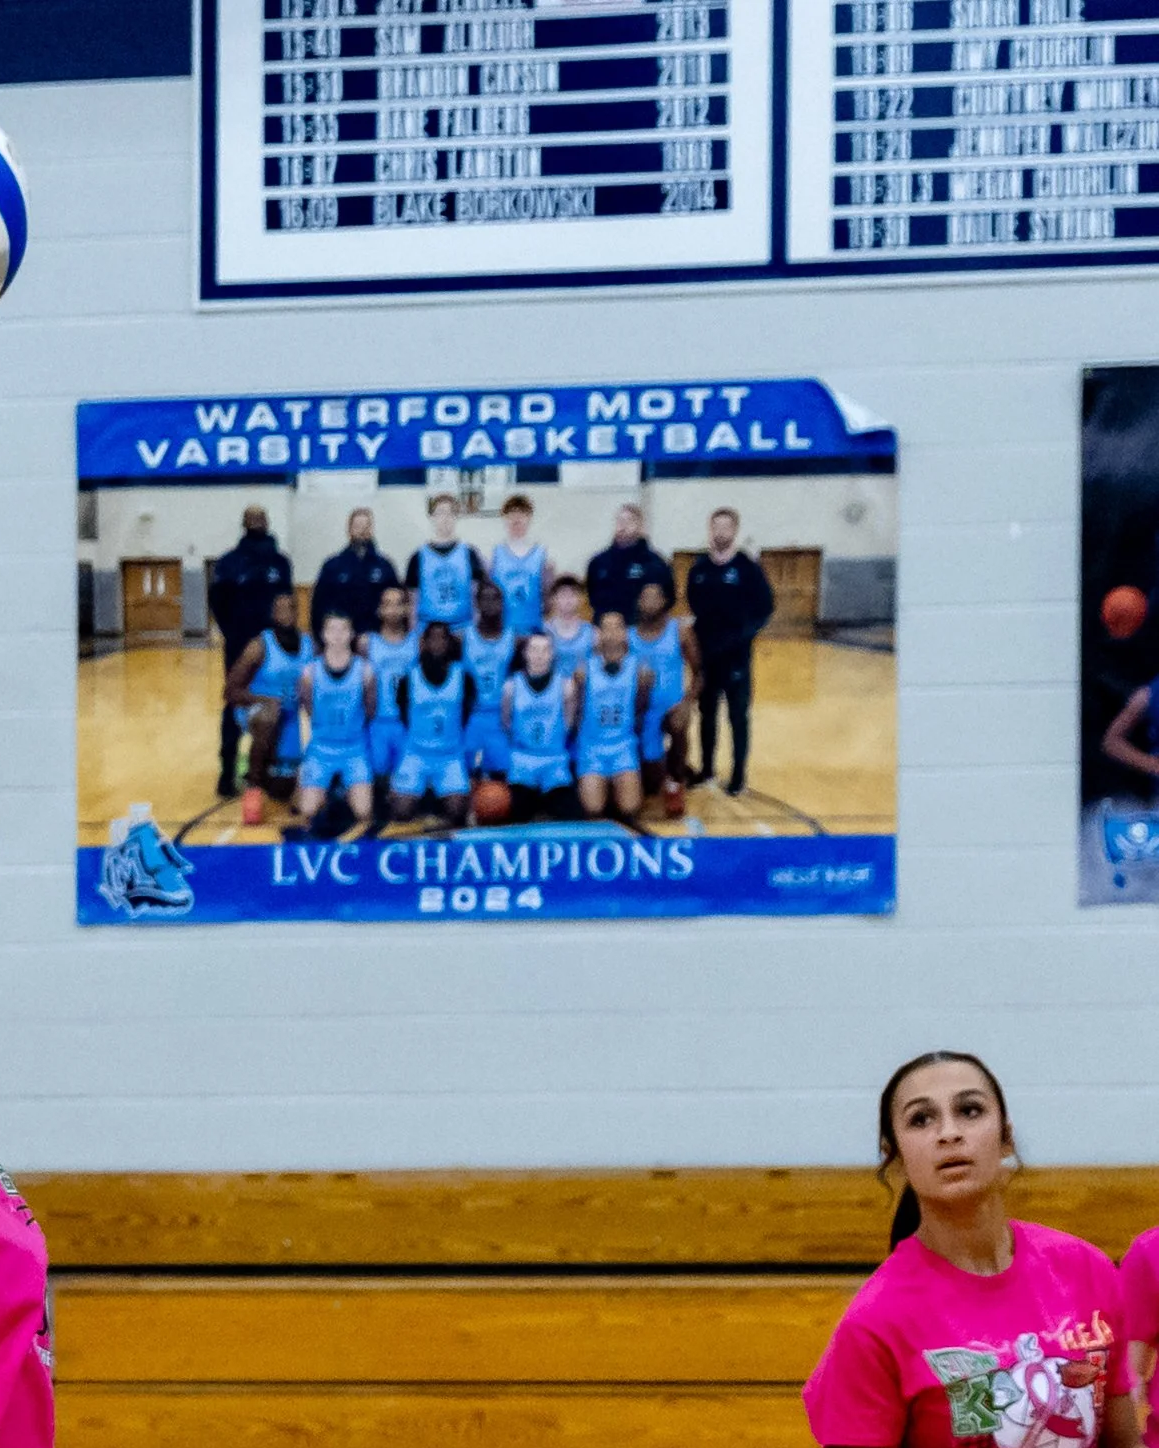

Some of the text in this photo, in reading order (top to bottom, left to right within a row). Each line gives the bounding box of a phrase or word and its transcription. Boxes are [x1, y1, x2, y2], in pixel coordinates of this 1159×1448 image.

[374, 190, 448, 224] BLAKE
[195, 386, 753, 433] WATERFORD MOTT
[137, 421, 813, 468] VARSITY BASKETBALL
[271, 838, 695, 887] LVC CHAMPIONS
[419, 886, 544, 912] 2024
